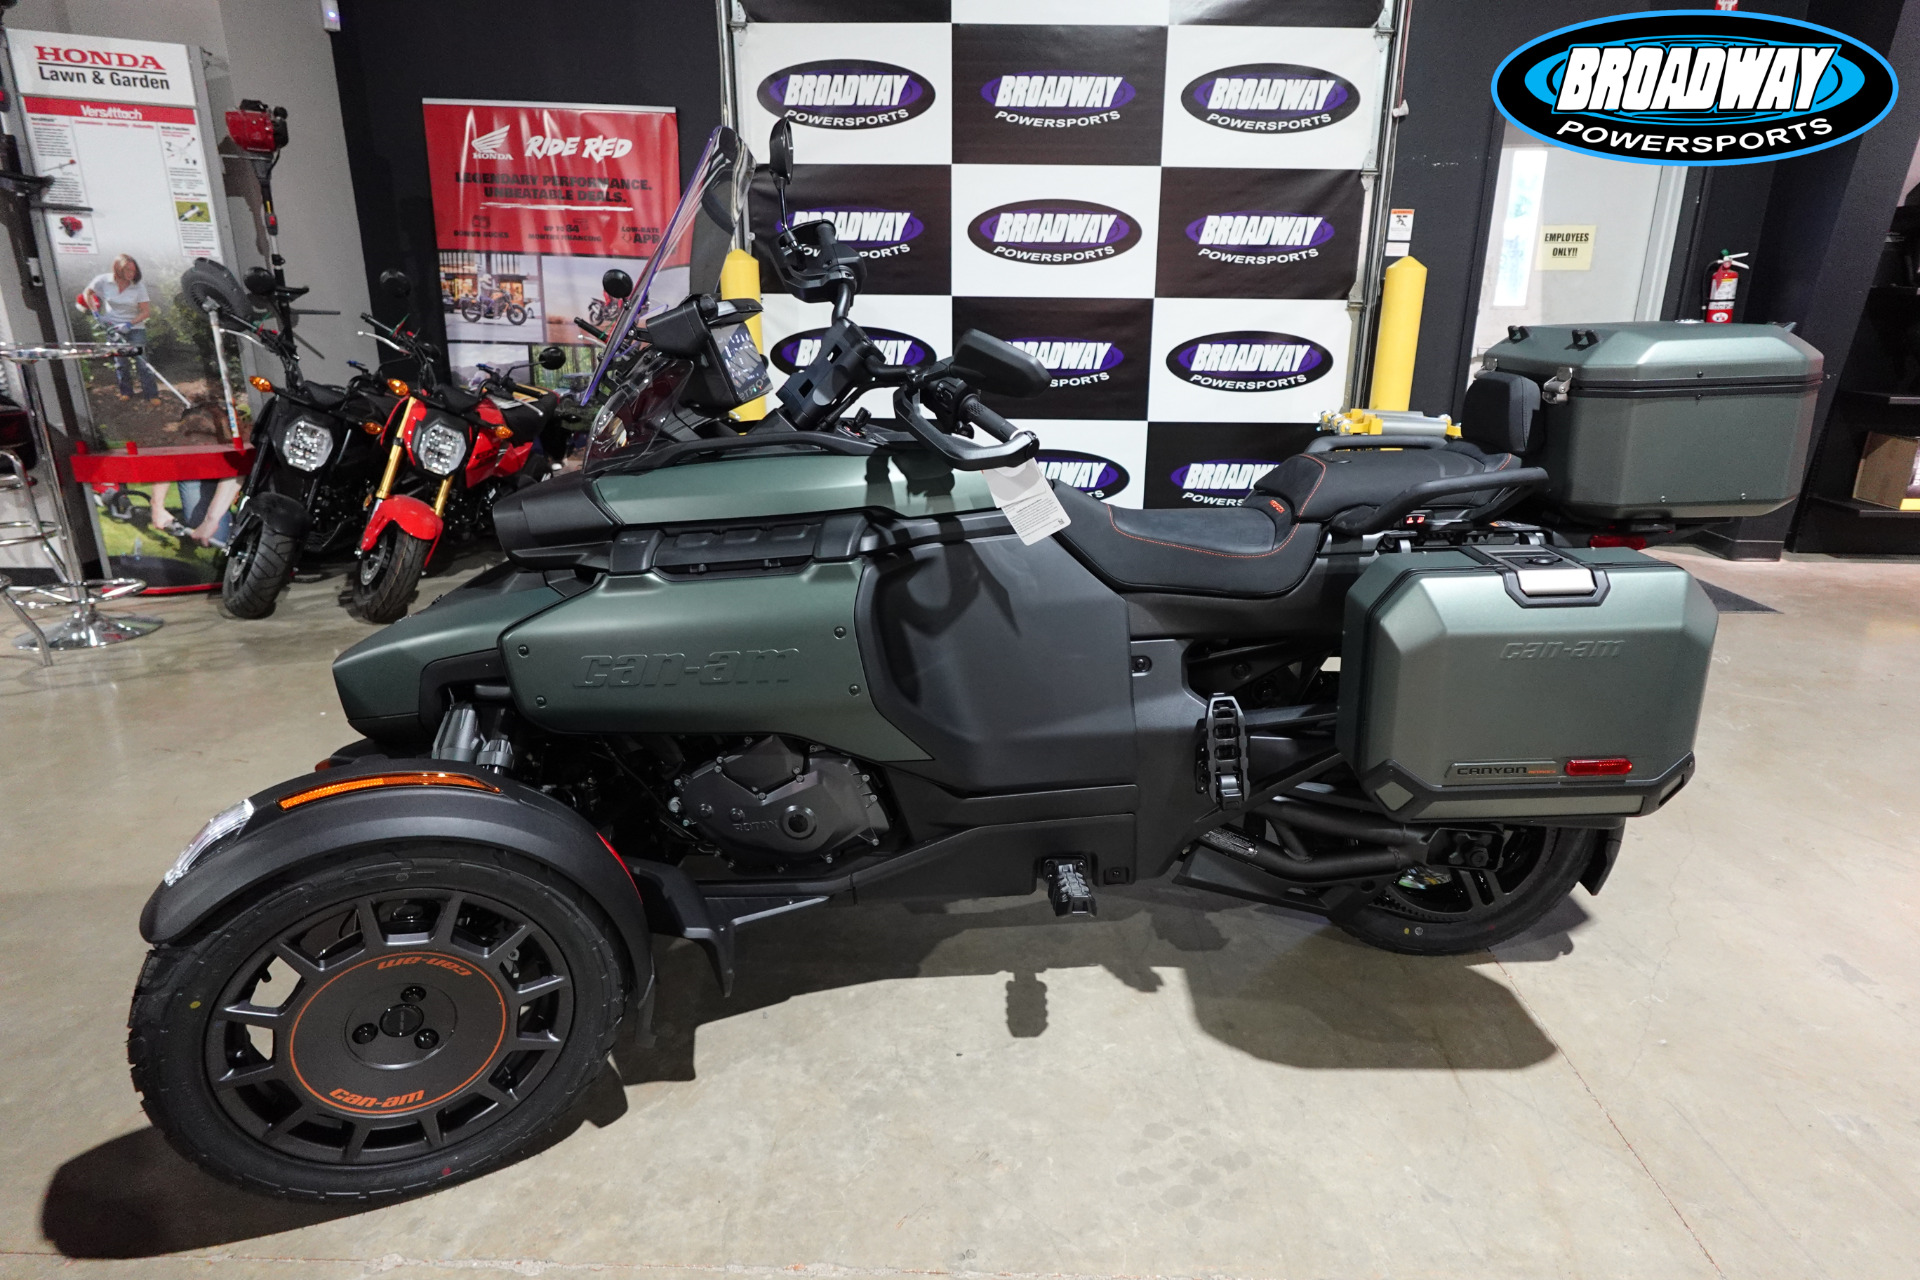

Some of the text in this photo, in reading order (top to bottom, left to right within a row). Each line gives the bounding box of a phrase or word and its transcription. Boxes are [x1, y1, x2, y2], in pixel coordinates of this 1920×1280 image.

[34, 46, 166, 70] HONDA
[39, 66, 170, 90] Lawn & Garden
[784, 75, 910, 106] BROADWAY
[995, 75, 1123, 107] BROADWAY
[1207, 78, 1336, 110] BROADWAY
[784, 109, 909, 127] POWERSPORTS
[995, 110, 1121, 128] POWERSPORTS
[1206, 113, 1332, 130] POWERSPORTS
[472, 152, 514, 160] HONDA
[524, 134, 633, 163] RIDE RED
[455, 172, 653, 191] LEGENDARY PERFORMANCE.
[484, 186, 627, 203] UNBEATABLE DEALS.
[994, 213, 1117, 243] BROADWAY
[1199, 215, 1323, 246] BROADWAY
[1544, 232, 1590, 242] EMPLOYEES
[634, 233, 661, 244] APR
[994, 246, 1115, 262] POWERSPORTS
[1198, 248, 1319, 264] POWERSPORTS
[1552, 247, 1578, 256] ONLY!!
[1190, 344, 1310, 372] BROADWAY
[1190, 374, 1307, 390] POWERSPORTS
[1500, 640, 1625, 660] can-am
[572, 648, 800, 688] can-am
[1457, 766, 1527, 775] CANYON
[329, 1088, 425, 1108] can-am
